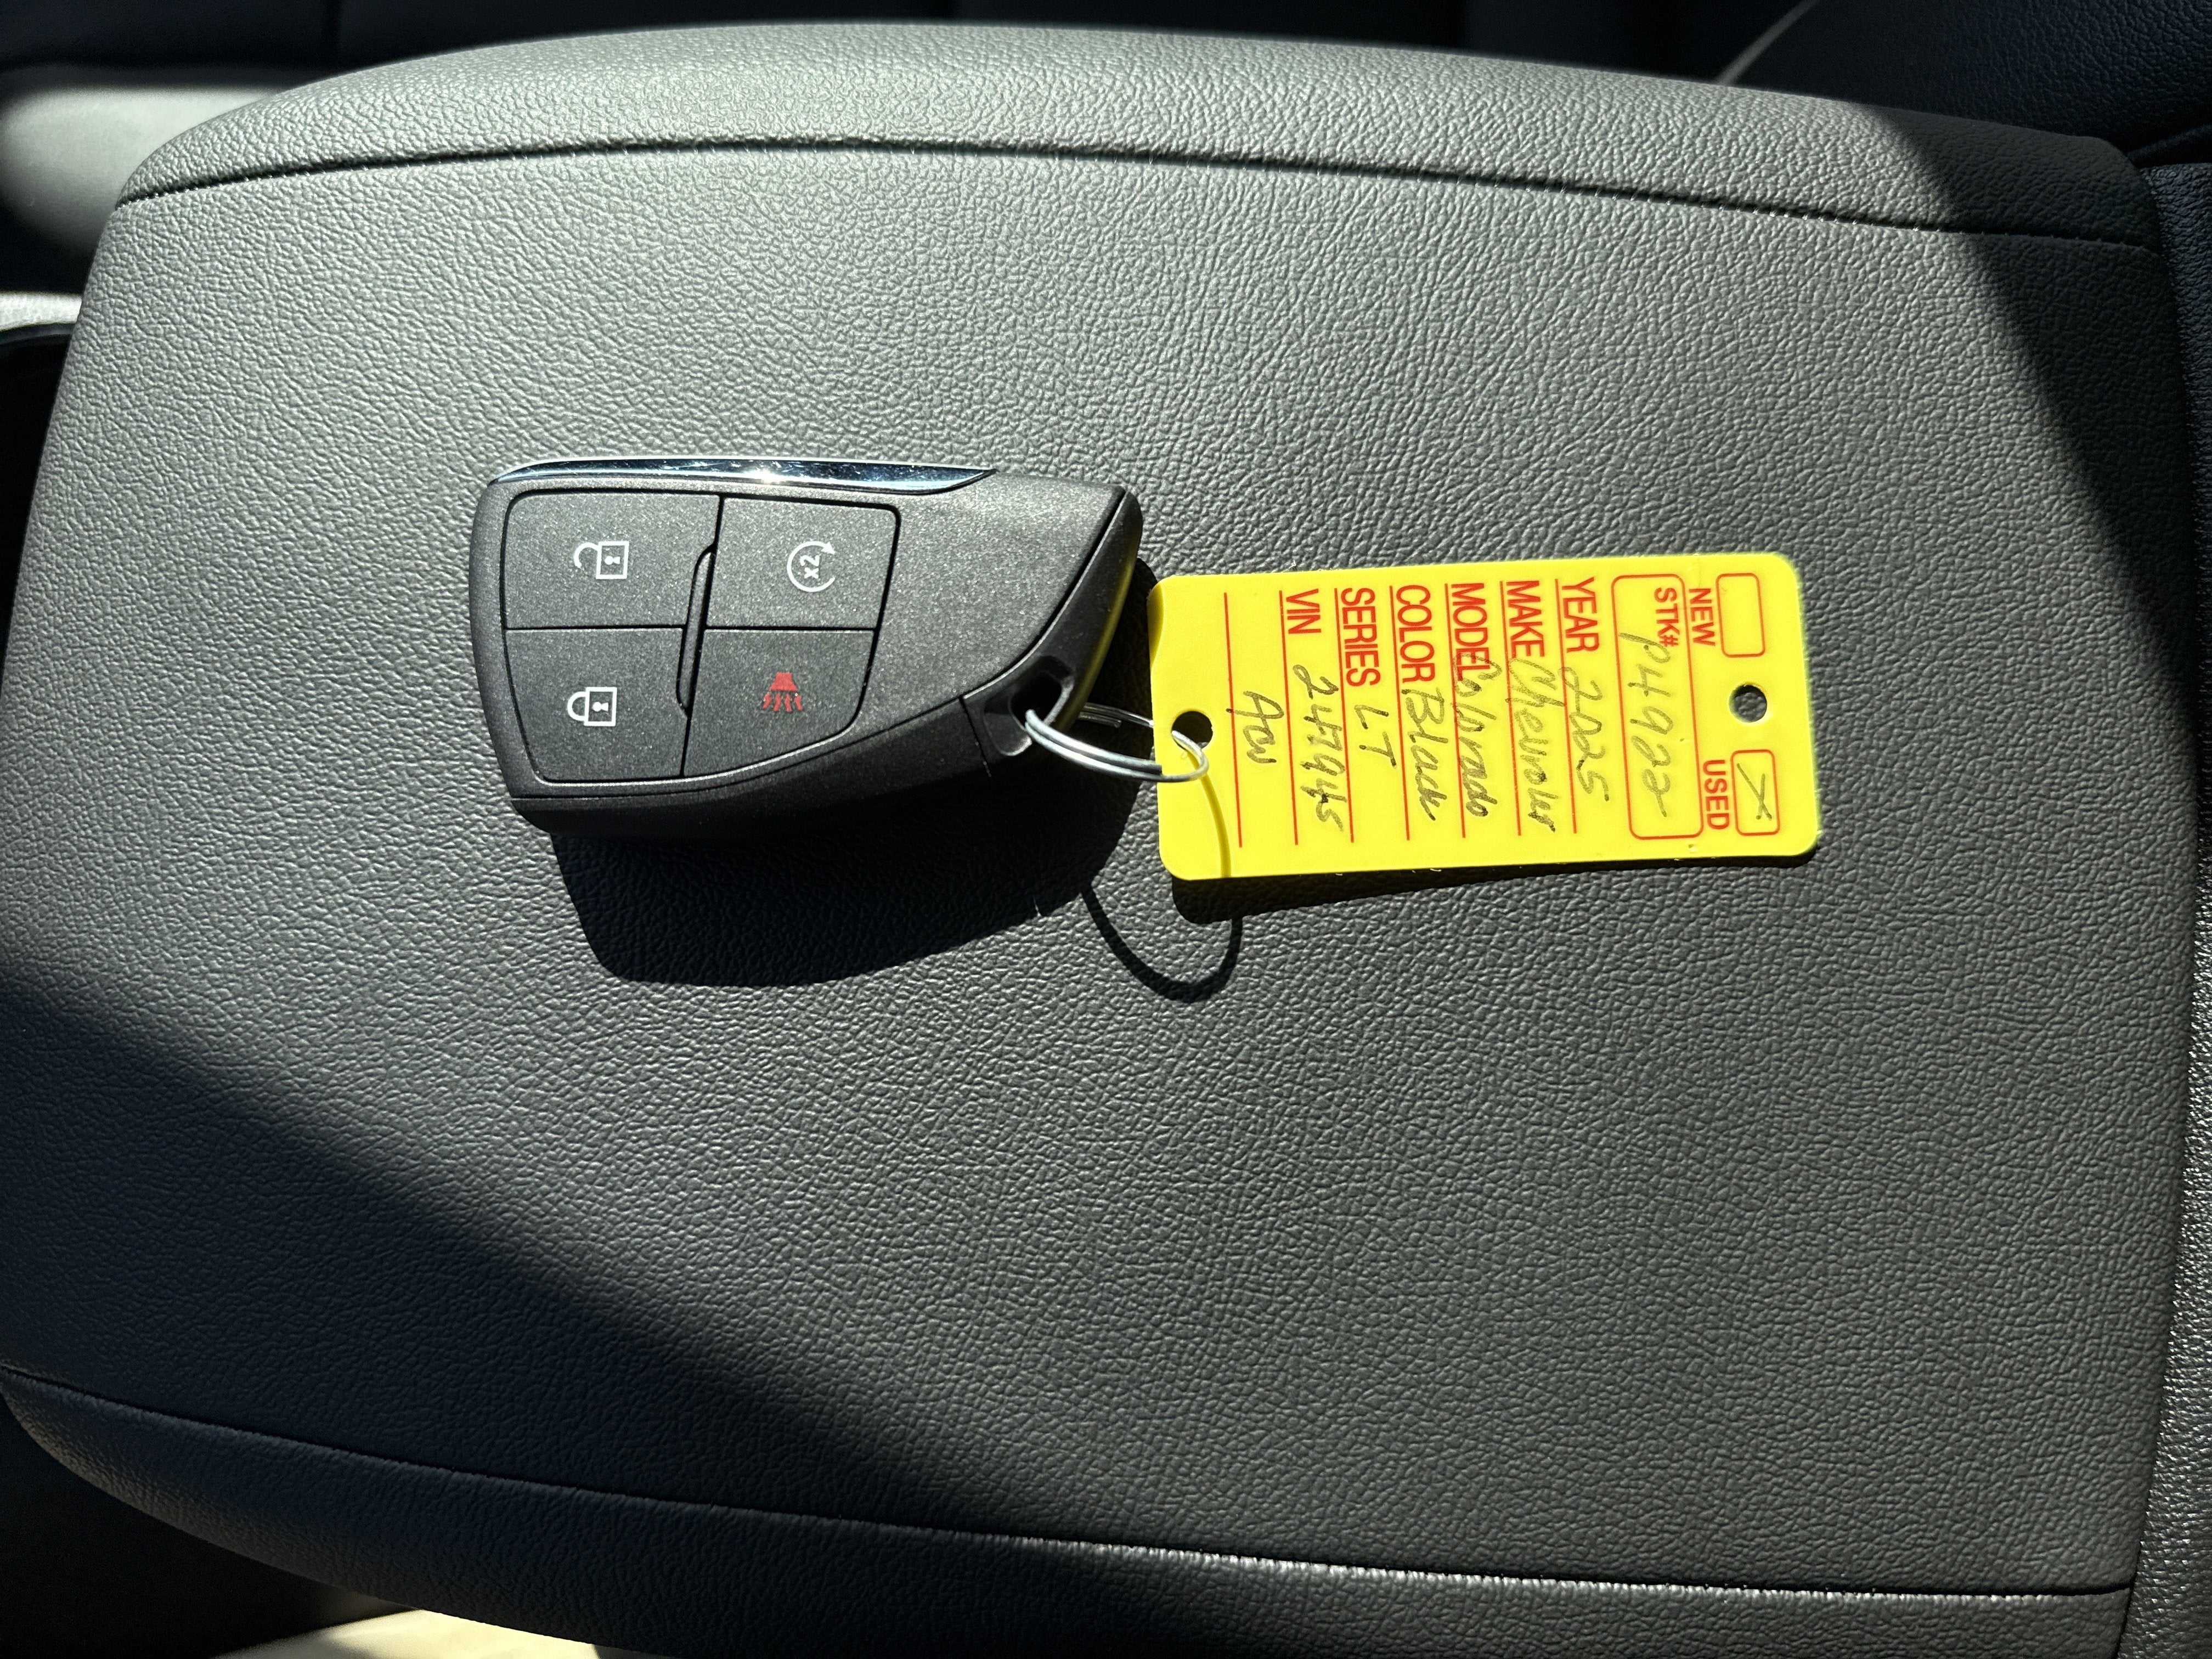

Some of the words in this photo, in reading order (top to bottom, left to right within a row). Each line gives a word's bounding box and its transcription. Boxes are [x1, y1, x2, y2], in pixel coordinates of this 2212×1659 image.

[1286, 589, 1322, 635] VIN
[1341, 588, 1381, 687] SERIES
[1396, 585, 1435, 683] COLOR
[1451, 583, 1491, 681] MODEL
[1506, 580, 1545, 658] MAKE
[1561, 577, 1600, 653] YEAR
[1654, 587, 1680, 647] STK#
[1689, 588, 1716, 646] NEW
[1354, 704, 1397, 768] LT
[1401, 687, 1448, 821] Black
[1559, 666, 1610, 802] 2025
[1702, 759, 1730, 830] USED
